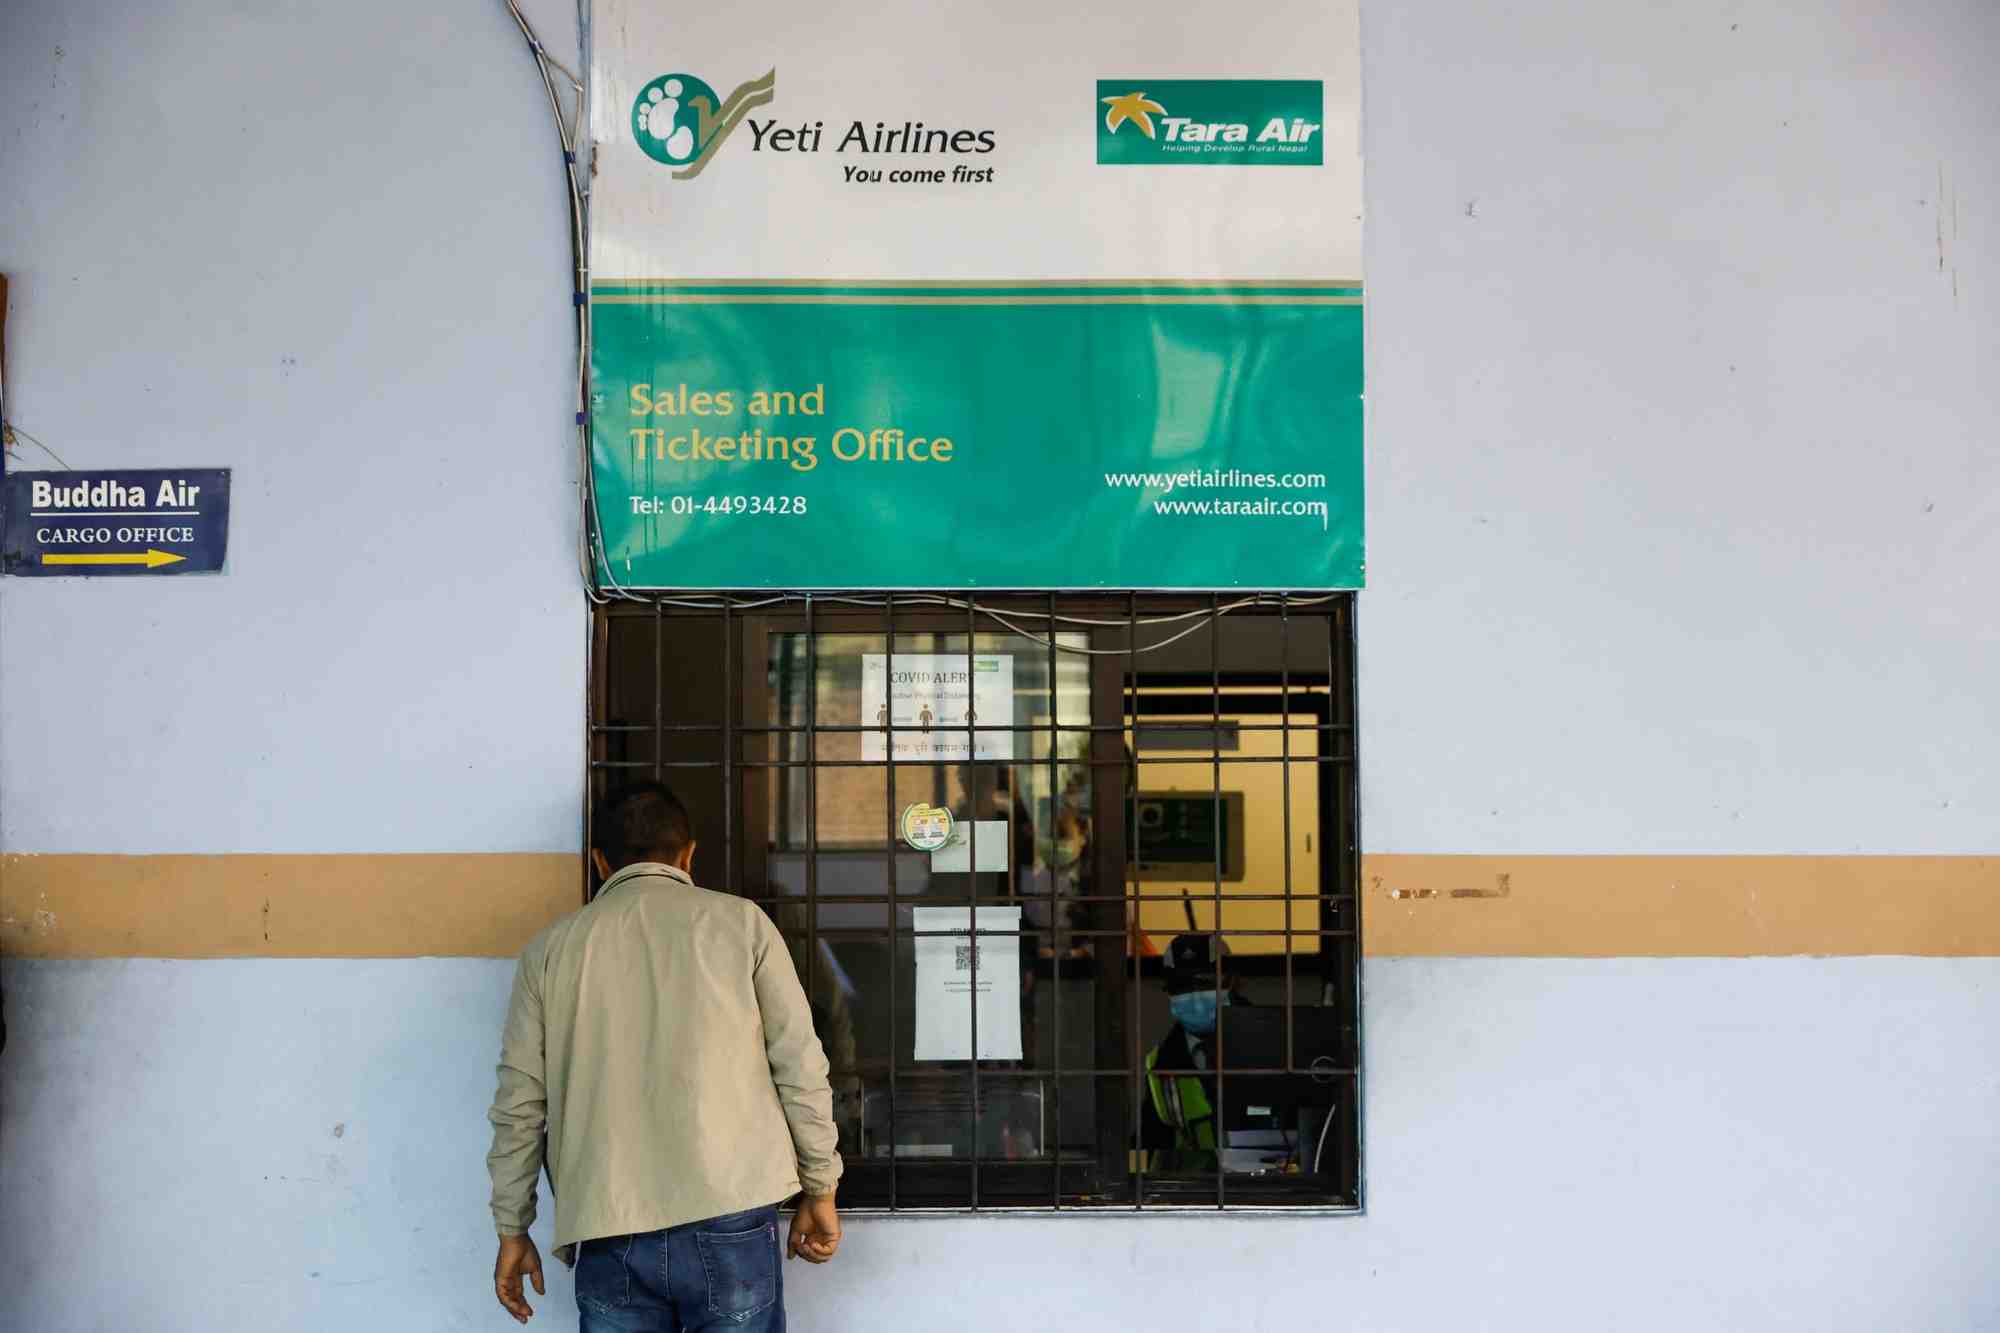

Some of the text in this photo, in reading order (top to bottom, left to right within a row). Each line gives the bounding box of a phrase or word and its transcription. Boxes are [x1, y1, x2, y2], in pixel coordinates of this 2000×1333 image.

[747, 119, 996, 154] Yeti Airlines
[1161, 117, 1321, 143] Tara Air
[1162, 144, 1201, 153] Helping
[1203, 144, 1245, 153] Develop
[843, 165, 994, 183] You come first
[630, 383, 825, 417] Sales and
[630, 428, 954, 472] Ticketing Office
[1104, 469, 1327, 493] www.yetiairlines.com
[31, 479, 201, 508] Buddha Air
[629, 496, 808, 515] Tel: 01-4493428
[1154, 497, 1327, 517] www.taraair.com
[36, 526, 195, 544] CARGO OFFICE
[890, 671, 931, 684] COVID
